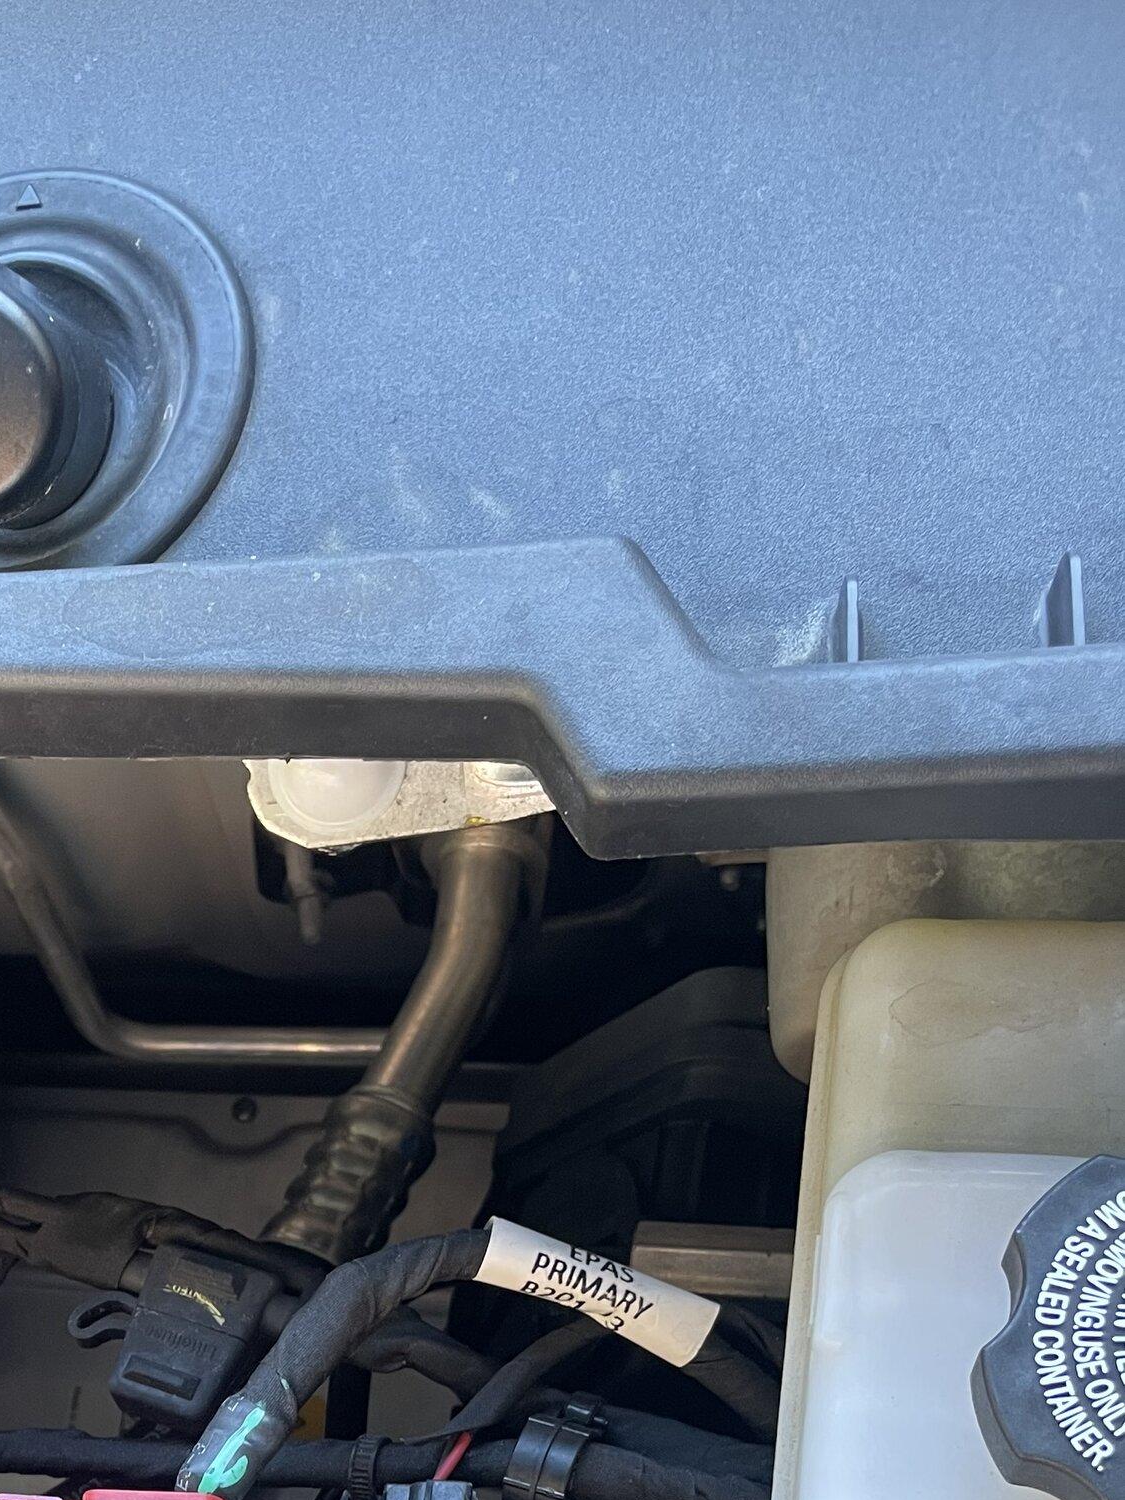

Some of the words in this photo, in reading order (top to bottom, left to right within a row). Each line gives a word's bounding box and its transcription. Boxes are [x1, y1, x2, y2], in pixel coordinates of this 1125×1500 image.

[1076, 1216, 1107, 1241] A
[531, 1252, 654, 1319] PRIMARY
[571, 1246, 634, 1283] EPAS
[1035, 1235, 1095, 1326] SEALED
[1032, 1329, 1114, 1472] CONTAINER.
